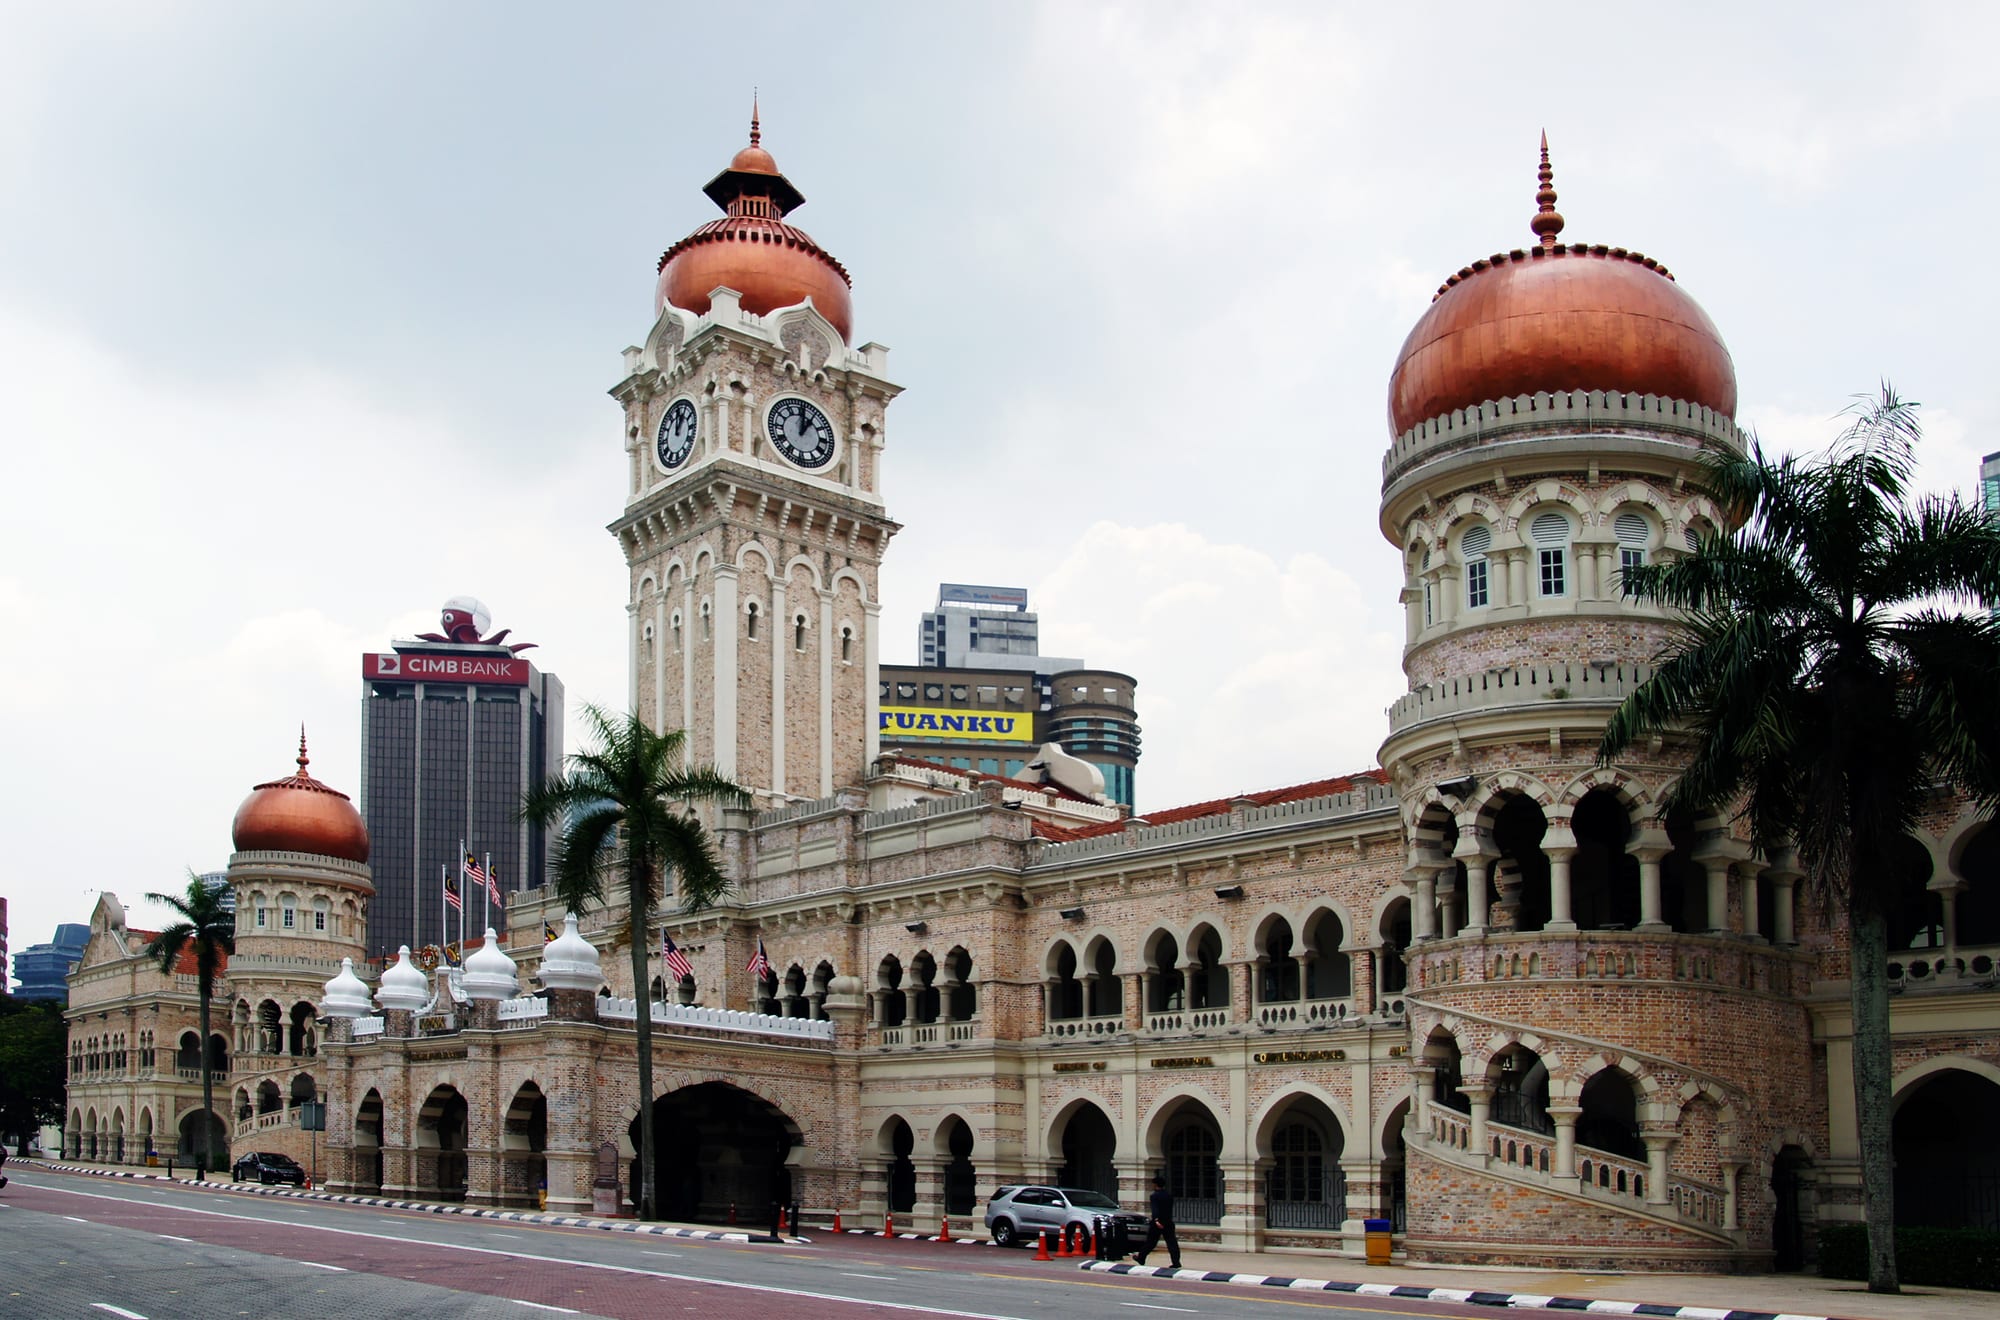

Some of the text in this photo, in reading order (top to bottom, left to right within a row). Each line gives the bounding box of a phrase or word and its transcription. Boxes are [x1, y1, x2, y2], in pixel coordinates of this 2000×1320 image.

[408, 658, 512, 676] CIMB BANK
[879, 712, 1015, 733] TUANKU
